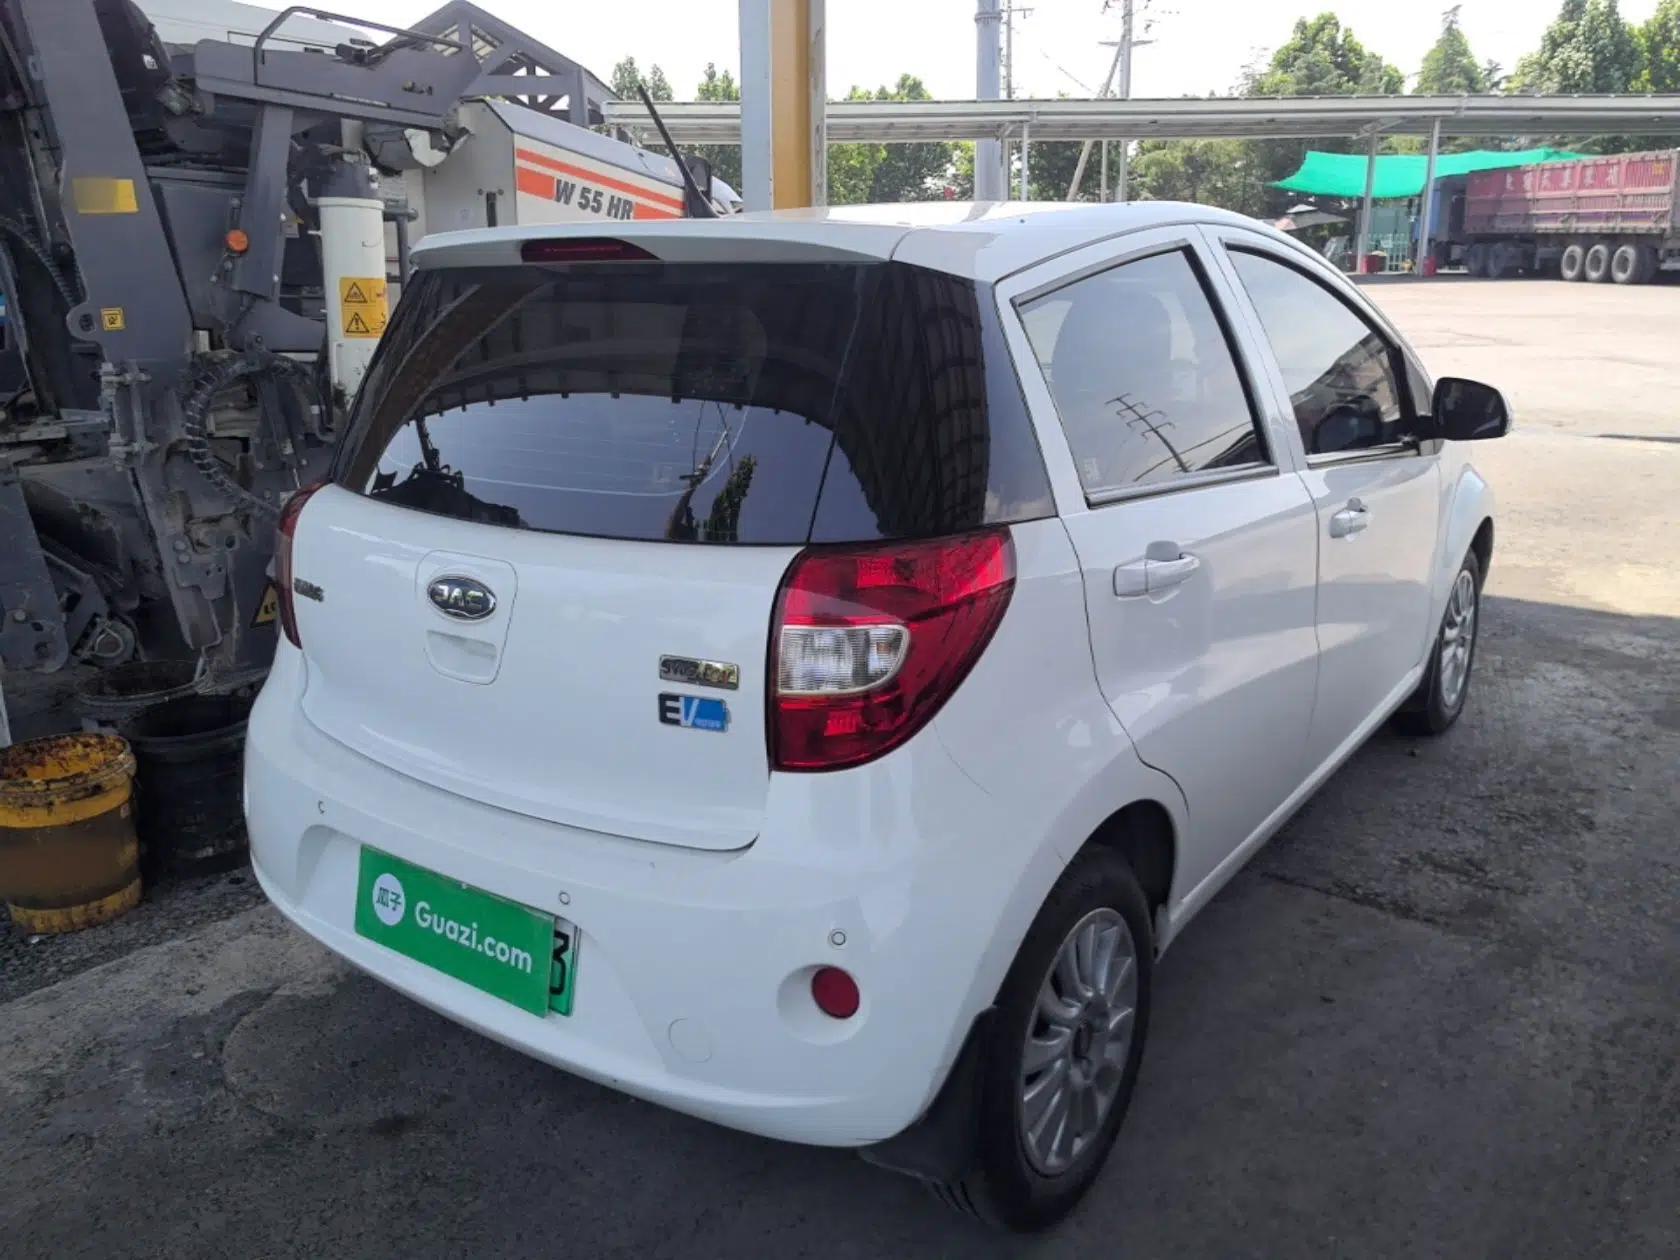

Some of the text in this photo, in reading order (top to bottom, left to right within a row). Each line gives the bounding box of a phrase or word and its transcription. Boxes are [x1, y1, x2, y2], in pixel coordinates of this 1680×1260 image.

[554, 178, 633, 220] W 55 HR
[430, 584, 485, 611] JAC
[658, 693, 700, 728] EV
